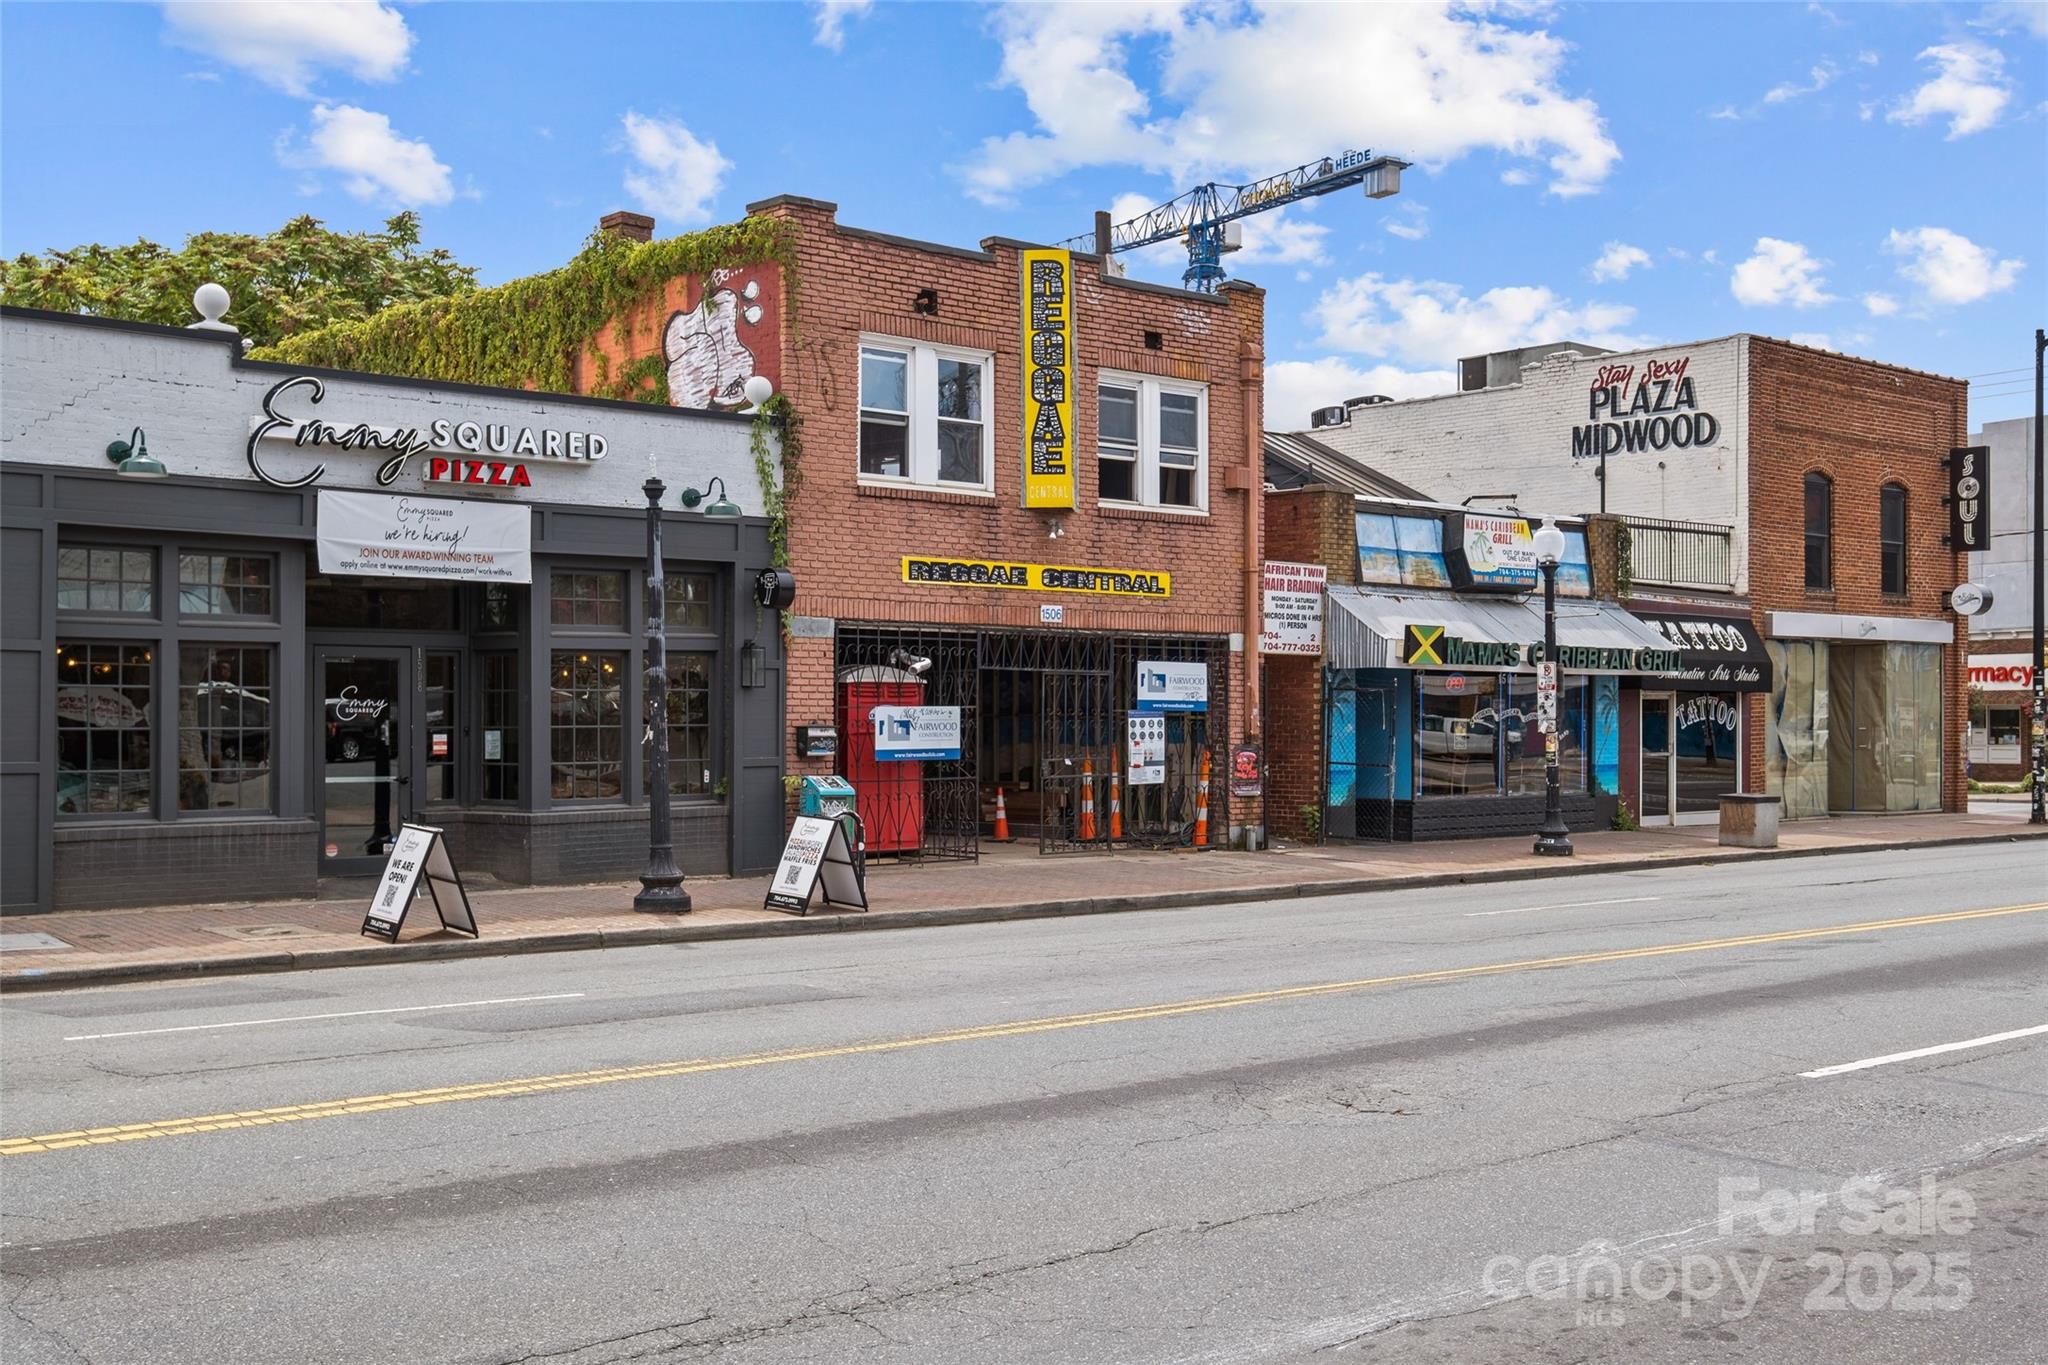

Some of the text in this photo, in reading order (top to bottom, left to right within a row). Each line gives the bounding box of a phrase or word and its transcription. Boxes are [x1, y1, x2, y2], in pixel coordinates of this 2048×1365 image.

[1335, 149, 1371, 171] HEEDE
[1030, 259, 1066, 474] REGGAE
[1592, 357, 1689, 400] Stay Sexy
[1590, 377, 1698, 420] PLAZA
[247, 376, 609, 488] Emmy SQUARED
[1572, 413, 1720, 459] MIDWOOD
[430, 457, 531, 487] PIZZA
[1029, 485, 1069, 499] CENTRAL
[1957, 454, 1980, 545] SOUL
[397, 498, 454, 523] Emmy SQUARED
[1490, 520, 1525, 534] CARIBBEAN
[384, 524, 469, 556] we're hiring!
[1492, 533, 1513, 545] GRILL
[359, 548, 494, 564] JOIN OUR AWARD-WINNING TEAM
[340, 561, 358, 570] apply
[359, 561, 378, 569] online
[1265, 565, 1324, 578] AFRICAN TWIN
[908, 560, 1165, 593] REGGAE CENTRAL
[1264, 578, 1285, 592] HAIR
[1271, 595, 1292, 603] MONDAY
[1041, 608, 1062, 621] 1506
[1264, 612, 1285, 620] MICROS
[1286, 613, 1300, 621] DONE
[1311, 634, 1316, 642] 2
[1263, 642, 1321, 652] 704-777-0325
[1447, 637, 1686, 671] MAMA'S CRIBBEAN GRILL
[1168, 676, 1205, 686] FAIRWOOD
[1708, 664, 1731, 681] Arts
[1733, 664, 1760, 682] Studio
[336, 685, 388, 721] Emmy
[1675, 696, 1737, 731] TATTOO
[915, 722, 958, 732] FAIRWOOD
[392, 859, 415, 872] WE ARE
